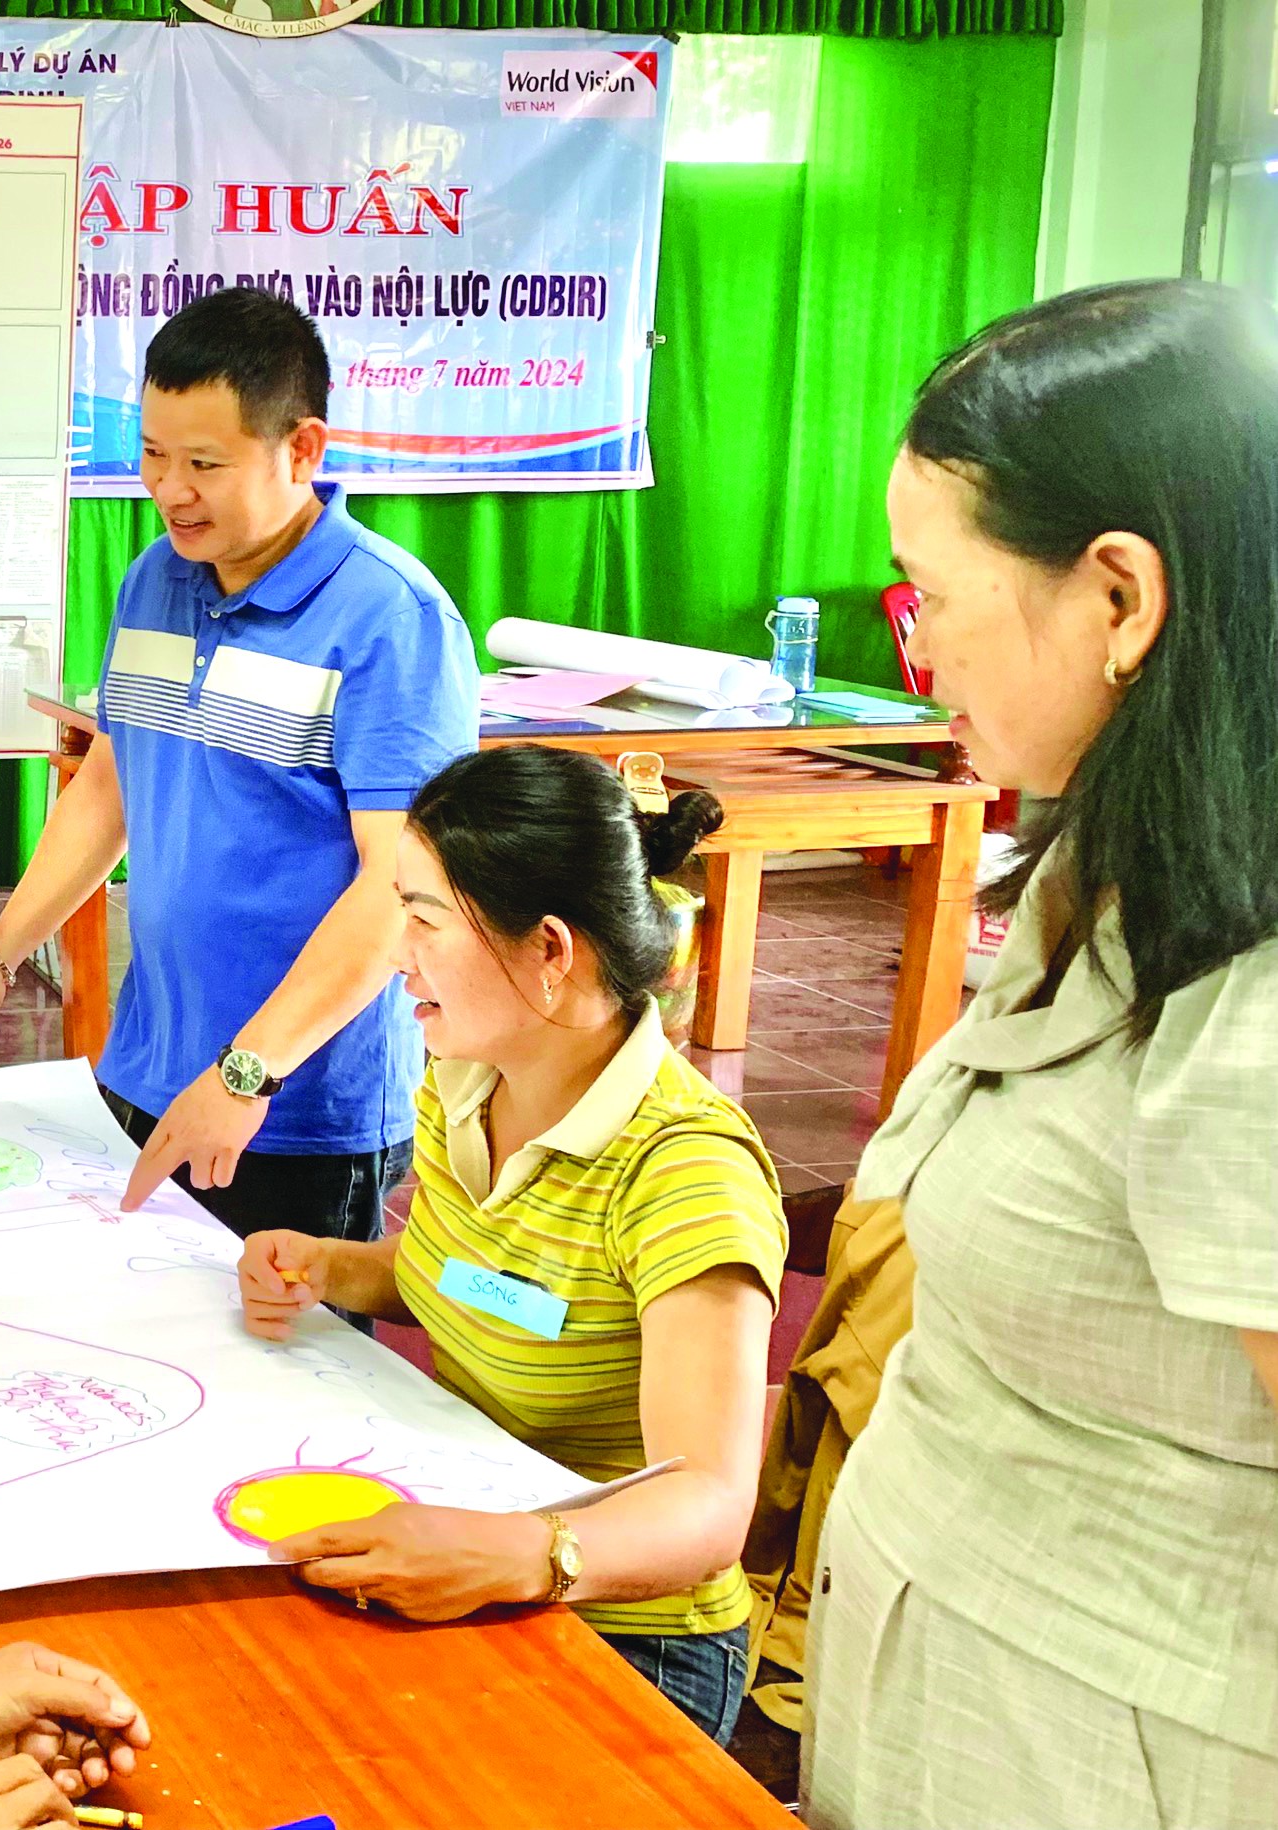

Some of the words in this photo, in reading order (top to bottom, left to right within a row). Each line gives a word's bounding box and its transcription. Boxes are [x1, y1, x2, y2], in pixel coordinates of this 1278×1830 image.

[33, 51, 70, 79] DỰ
[78, 48, 116, 73] ÁN
[507, 68, 569, 92] World
[575, 70, 635, 92] Vision
[530, 102, 554, 112] NAM
[212, 160, 474, 239] HUẤN
[305, 265, 362, 317] VÀO
[372, 265, 422, 326] NỘI
[434, 270, 491, 326] LỰC
[499, 273, 607, 322] (CDBIR)
[345, 358, 425, 394] tháng
[433, 359, 448, 387] 7
[454, 358, 511, 387] năm
[519, 359, 586, 388] 2024
